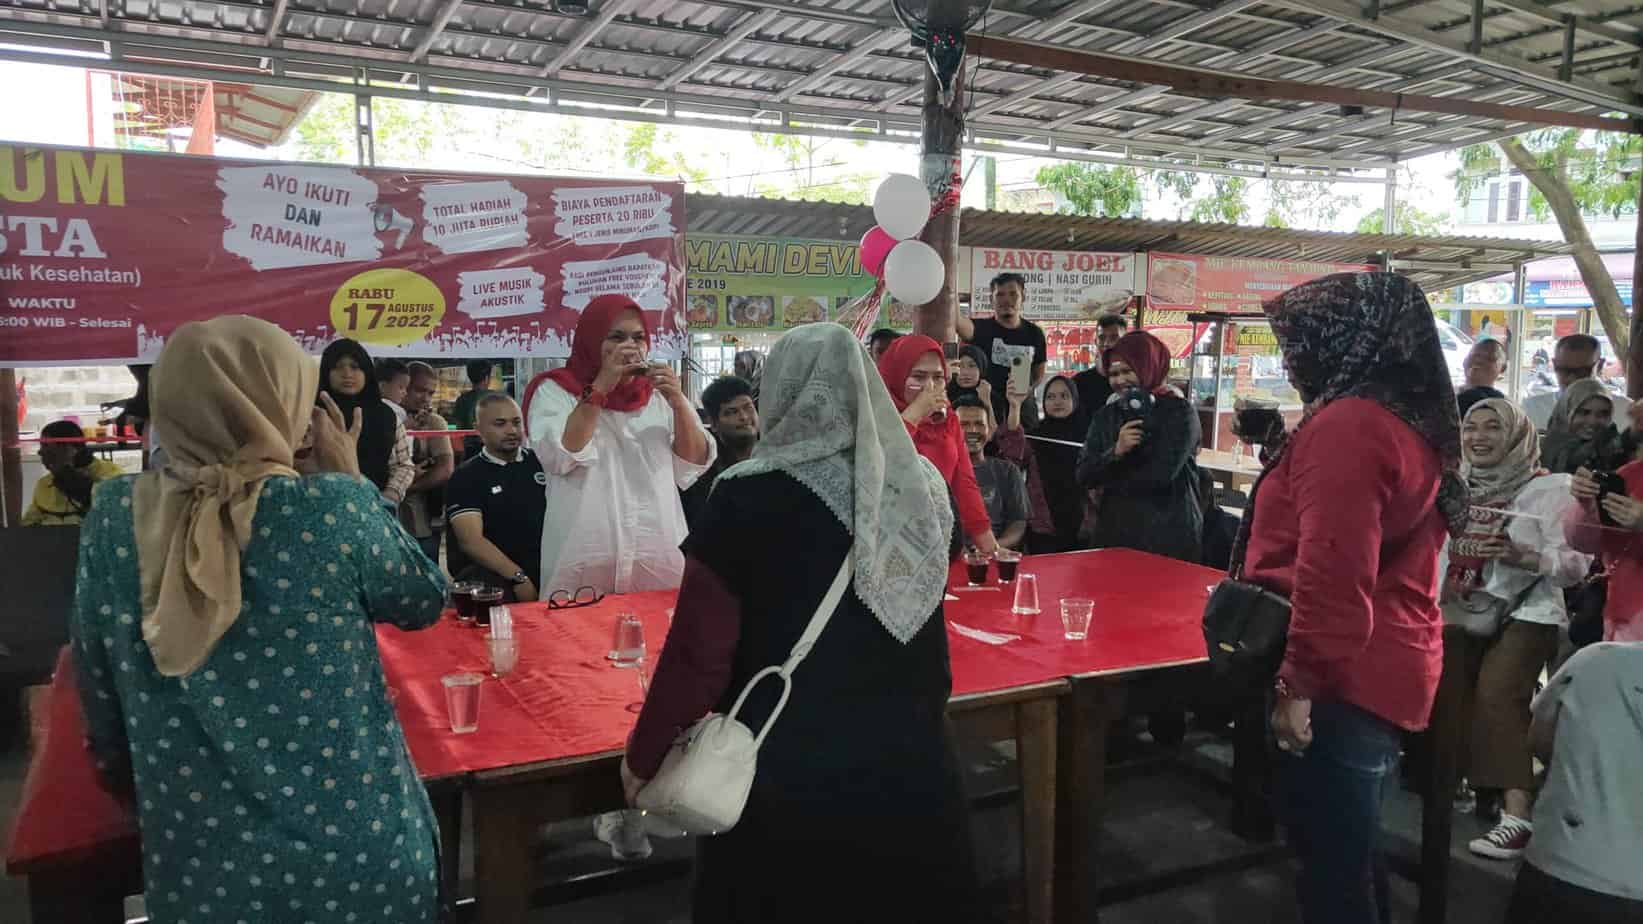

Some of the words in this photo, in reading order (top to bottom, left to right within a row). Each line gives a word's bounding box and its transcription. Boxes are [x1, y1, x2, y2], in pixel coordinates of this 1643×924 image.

[263, 173, 298, 194] AYO
[305, 183, 350, 206] IKUTI
[433, 204, 465, 216] TOTAL
[470, 198, 511, 212] HADIAH
[561, 199, 591, 211] BIAYA
[593, 192, 661, 207] PENDAFTARAN
[285, 204, 321, 226] DAN
[572, 212, 613, 225] PESERTA
[616, 211, 629, 222] 20
[633, 208, 655, 219] RIBU
[0, 215, 108, 259] TA
[433, 224, 446, 236] 10
[250, 223, 346, 258] RAMAIKAN
[687, 239, 778, 273] MAMI
[783, 243, 863, 276] DEVI
[983, 250, 1055, 270] BANG
[1062, 252, 1125, 272] JOEL
[30, 264, 141, 287] Kesehatan)
[697, 279, 726, 289] 2019
[1056, 274, 1078, 285] NASI
[348, 288, 395, 300] RABU
[473, 282, 496, 295] LIVE
[499, 278, 532, 291] MUSIK
[8, 298, 76, 309] WAKTU
[480, 294, 525, 307] AKUSTIK
[33, 317, 66, 327] WIB
[79, 318, 131, 328] Selesai
[343, 303, 385, 330] 17
[388, 303, 434, 313] AGUSTUS
[385, 315, 432, 328] 2022
